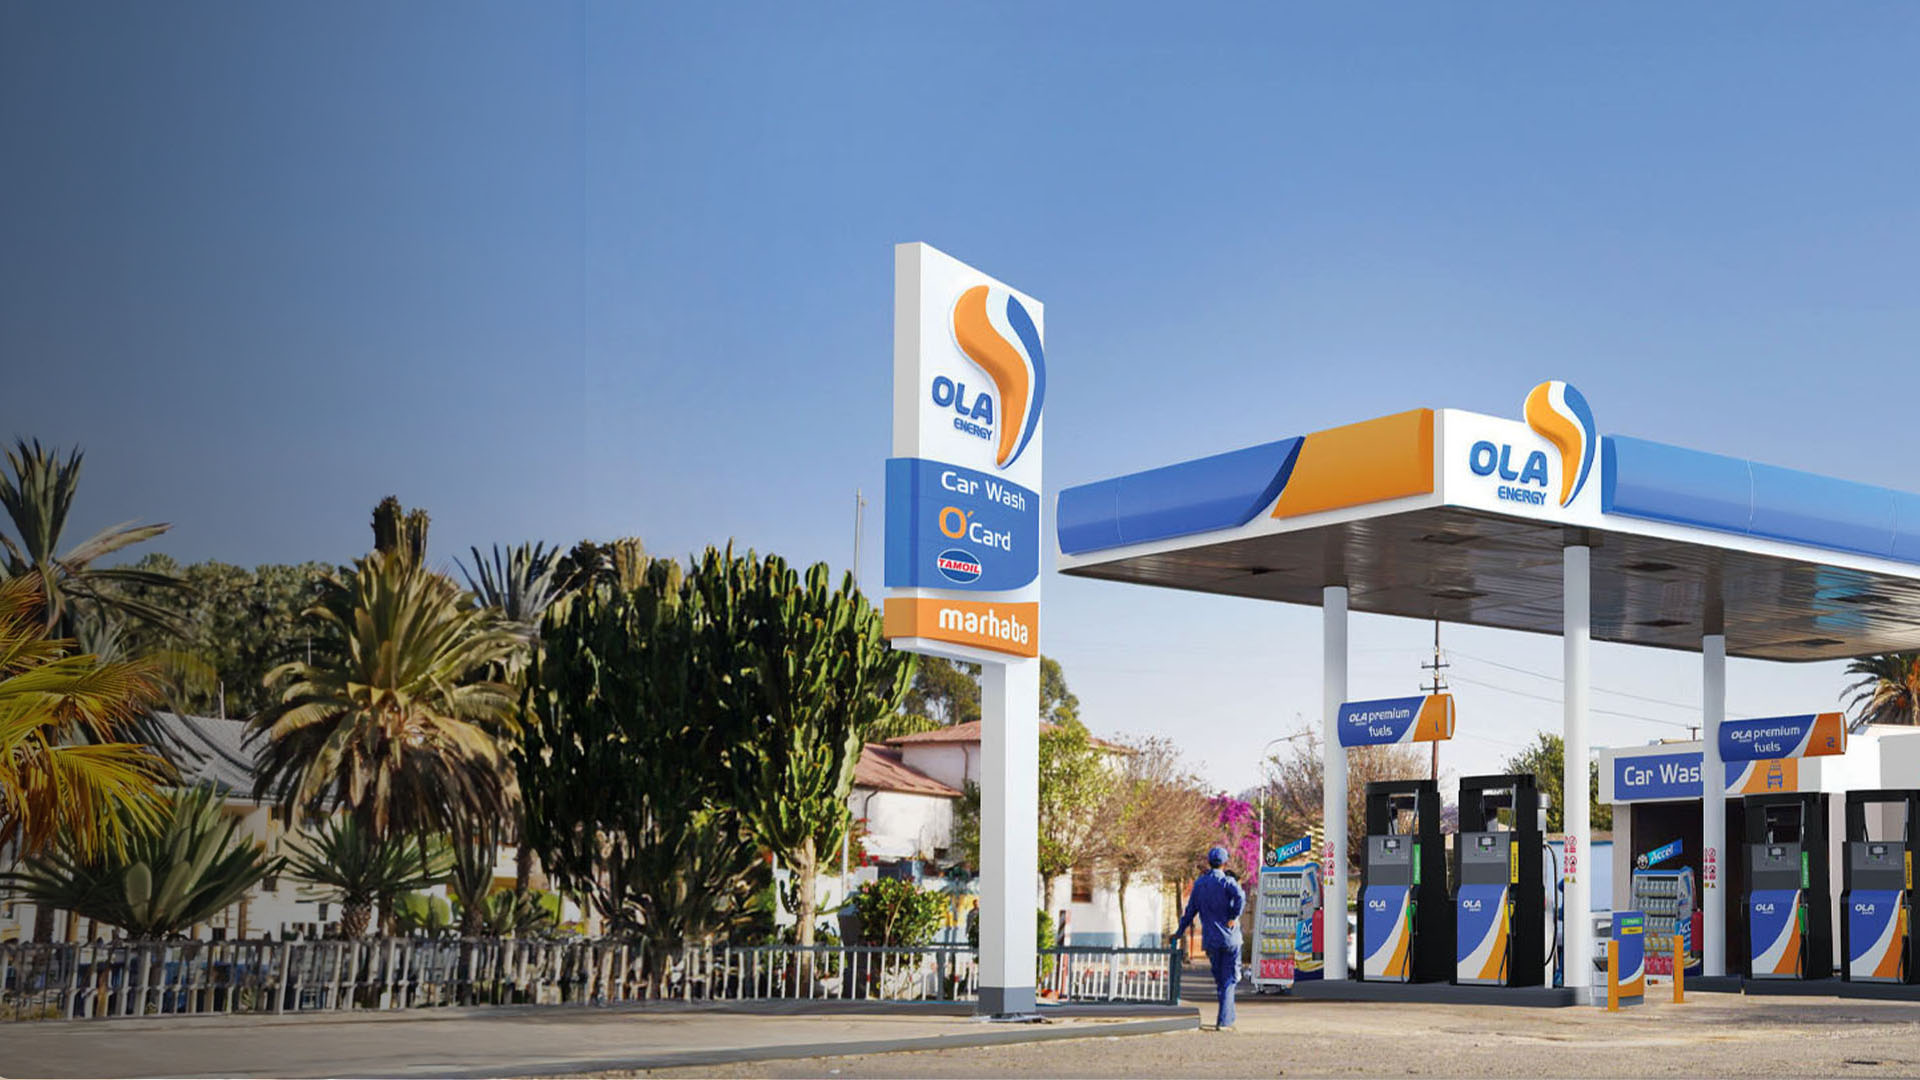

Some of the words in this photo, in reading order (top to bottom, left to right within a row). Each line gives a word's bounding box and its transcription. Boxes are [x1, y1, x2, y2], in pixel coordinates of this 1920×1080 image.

[932, 375, 993, 425] OLA
[953, 417, 993, 441] ENERGY
[1469, 440, 1549, 487] OLA
[941, 471, 979, 495] Car
[984, 480, 1026, 512] Wash
[1497, 485, 1547, 505] ENERGY
[938, 558, 980, 574] TAMOIL
[939, 607, 1029, 645] marhaba
[1349, 711, 1368, 723] OLA
[1368, 707, 1410, 724] premium
[1368, 724, 1393, 737] fuels
[1731, 729, 1752, 740] OLA
[1753, 726, 1800, 740] premium
[1754, 741, 1781, 753] fuels
[1825, 736, 1835, 748] 2
[1624, 766, 1653, 786] Car
[1659, 763, 1704, 785] Was
[1279, 840, 1303, 859] Accel
[1369, 899, 1386, 909] OLA
[1463, 899, 1481, 909] OLA
[1755, 903, 1775, 912] OLA
[1855, 903, 1875, 913] OLA
